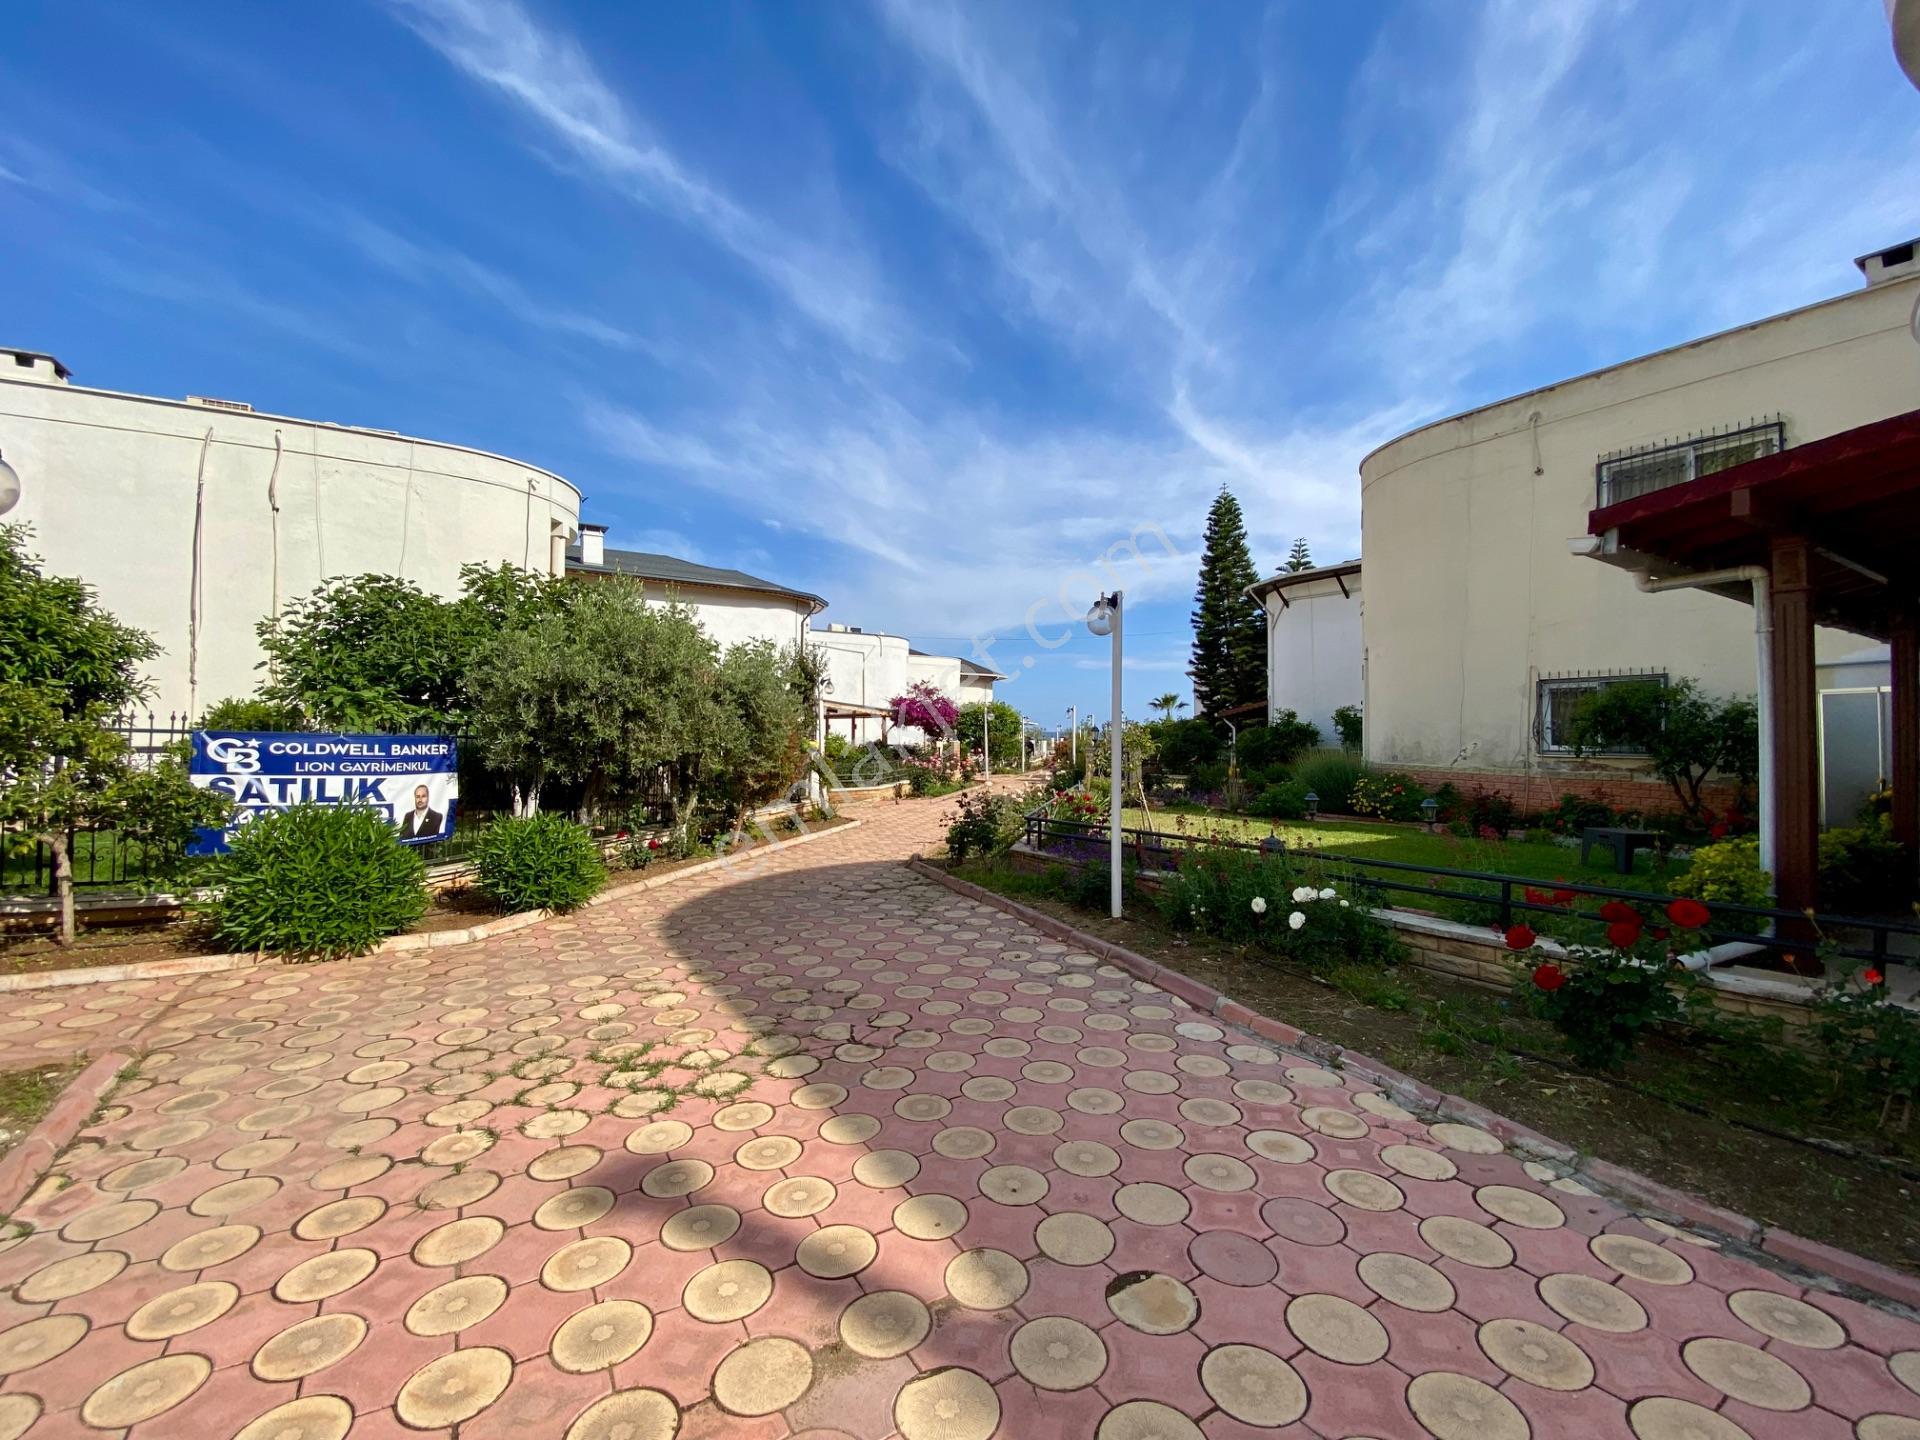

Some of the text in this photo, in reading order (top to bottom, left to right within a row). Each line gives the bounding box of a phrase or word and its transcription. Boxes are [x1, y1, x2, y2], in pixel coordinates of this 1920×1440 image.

[269, 742, 449, 756] COLDWELL BANKER
[295, 760, 432, 773] LION GAYRİMENKUL
[209, 776, 388, 804] SATILIK
